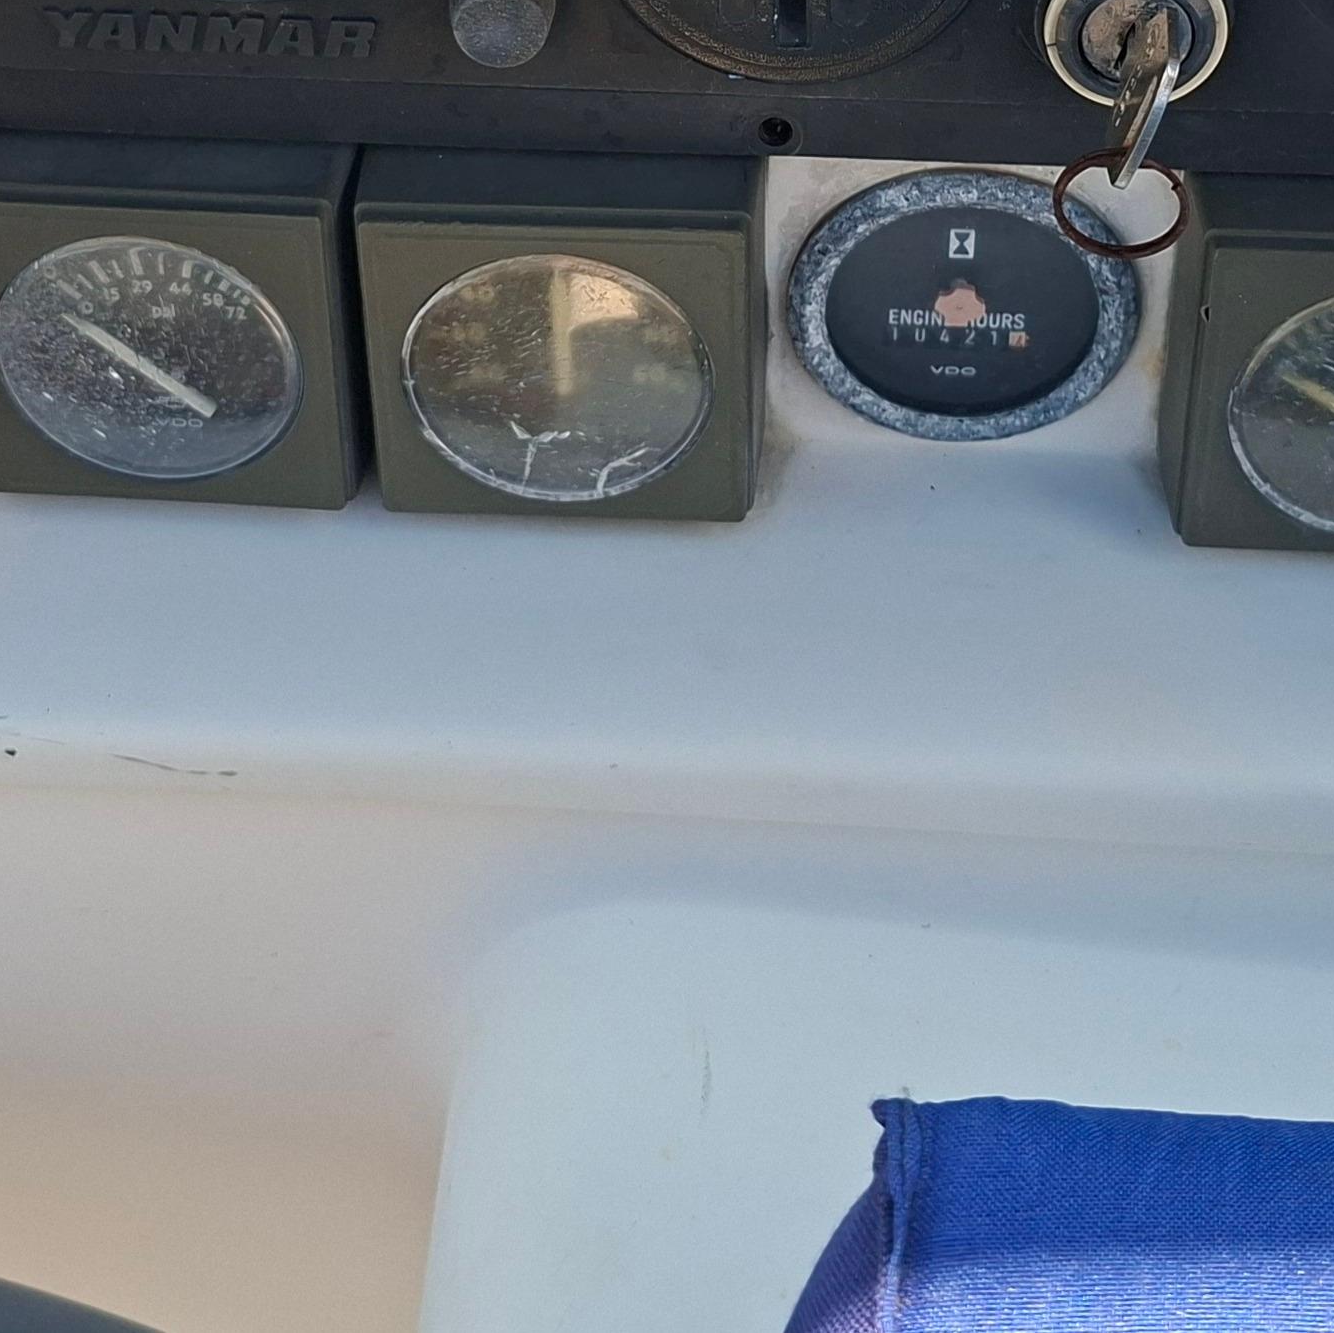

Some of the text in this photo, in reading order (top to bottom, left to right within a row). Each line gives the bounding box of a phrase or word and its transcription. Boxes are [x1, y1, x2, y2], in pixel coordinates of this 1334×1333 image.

[44, 7, 378, 60] YANMAR
[888, 308, 947, 326] ENGIN
[930, 365, 977, 377] VDO
